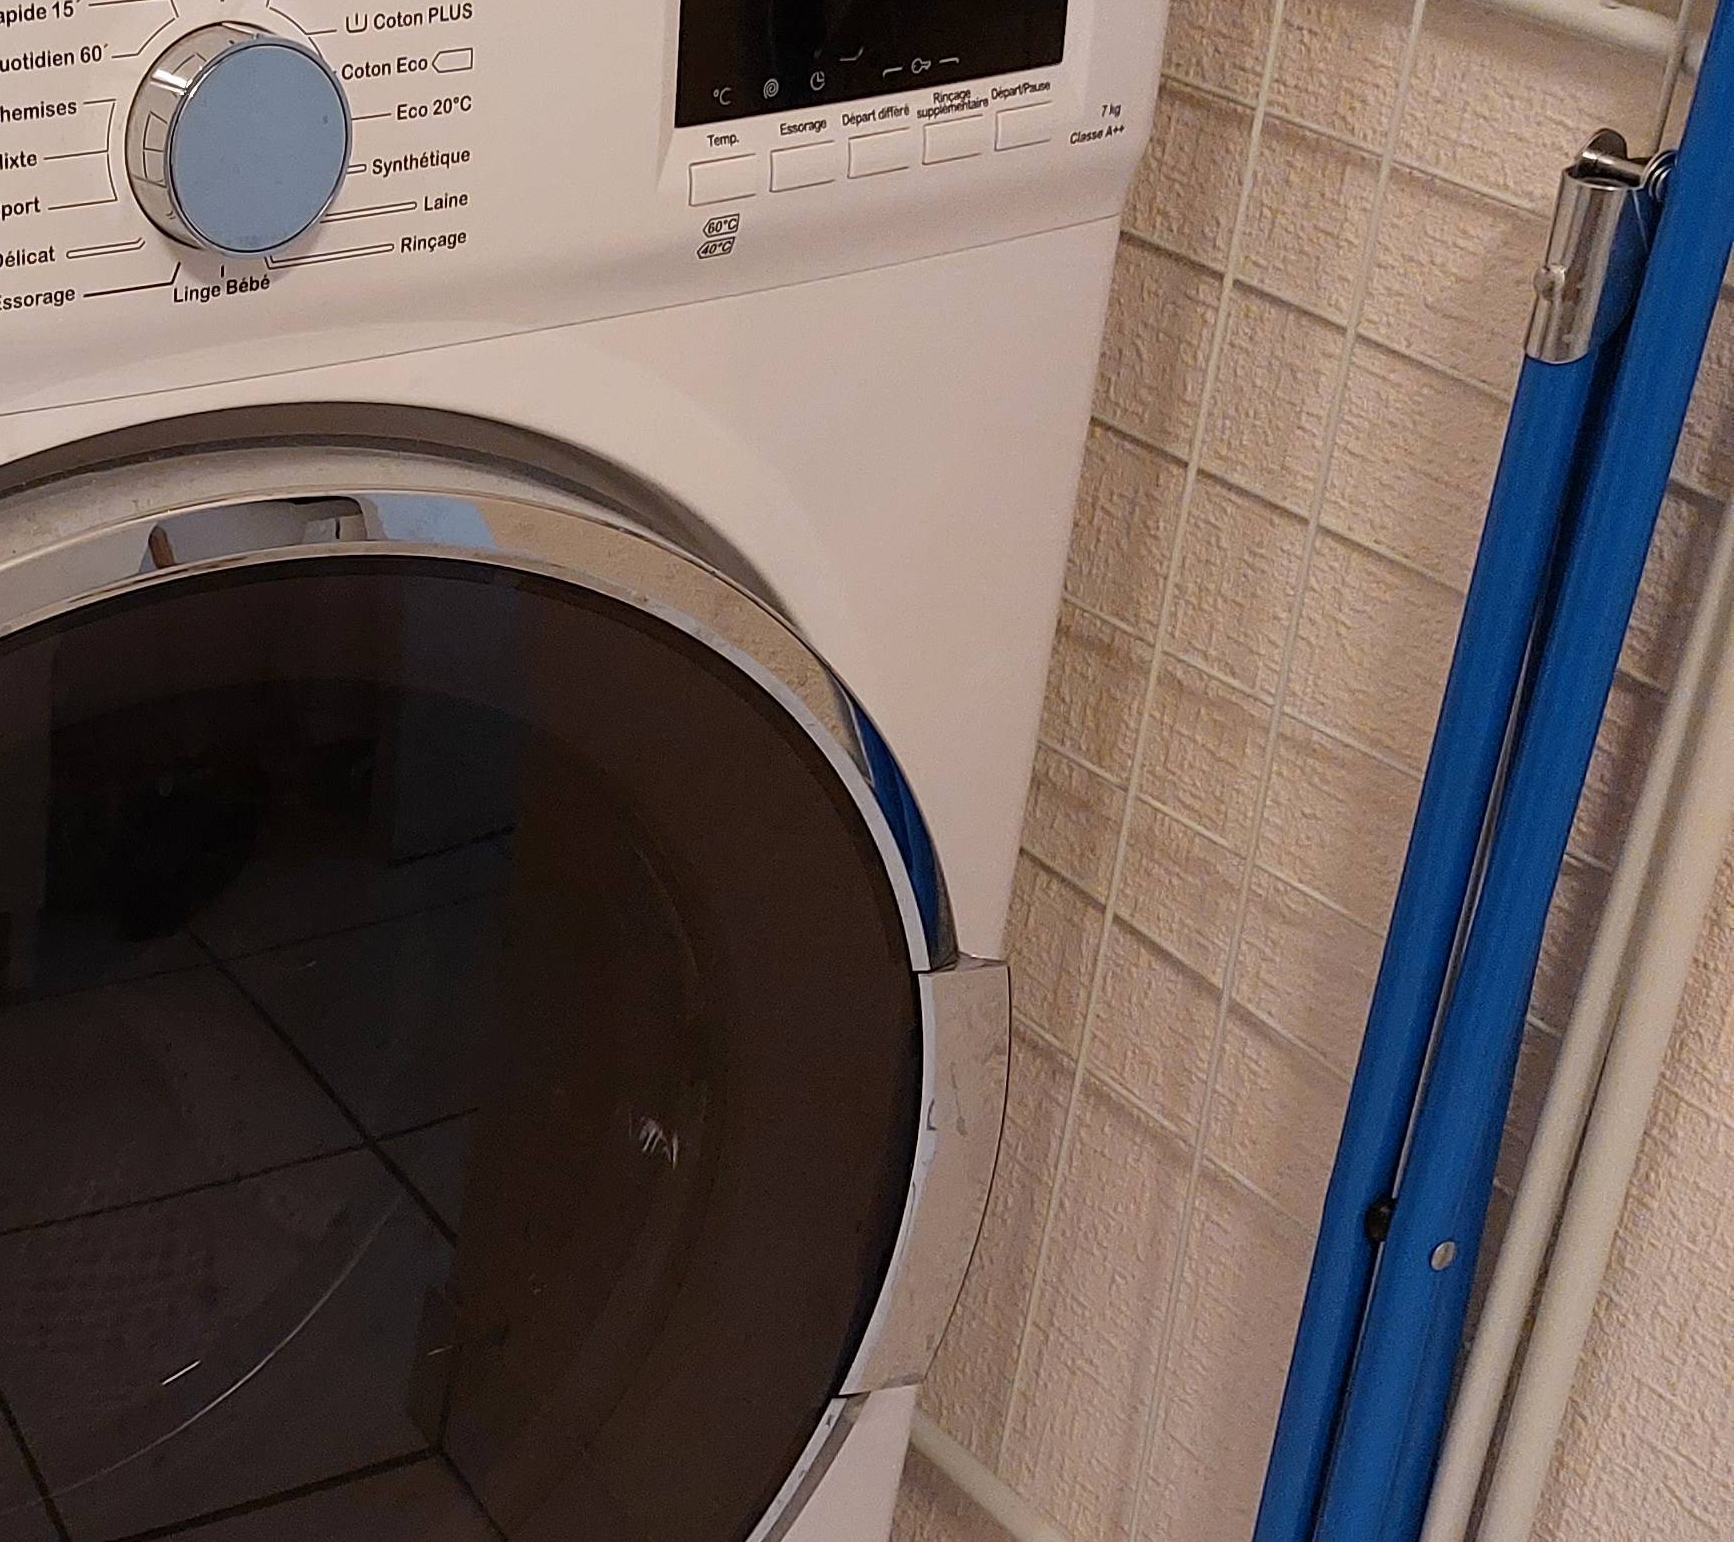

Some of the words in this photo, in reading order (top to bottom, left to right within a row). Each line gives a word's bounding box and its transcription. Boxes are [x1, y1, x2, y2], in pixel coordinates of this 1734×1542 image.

[373, 11, 423, 31] Coton
[427, 2, 473, 24] PLUS
[341, 61, 392, 81] Coton
[396, 56, 428, 75] Eco
[932, 87, 972, 106] Rinçage
[990, 80, 1051, 100] Départ/Pause
[396, 102, 428, 121] Eco
[841, 107, 876, 127] Départ
[1100, 105, 1108, 118] 7
[1108, 104, 1122, 118] kg
[779, 119, 827, 136] Essorage
[1069, 128, 1104, 145] Classe
[706, 133, 740, 148] Temp.
[372, 149, 471, 178] Synthétique
[424, 192, 469, 212] Laine
[400, 231, 468, 254] Rinçage
[172, 283, 222, 304] Linge
[225, 275, 271, 296] Bébé
